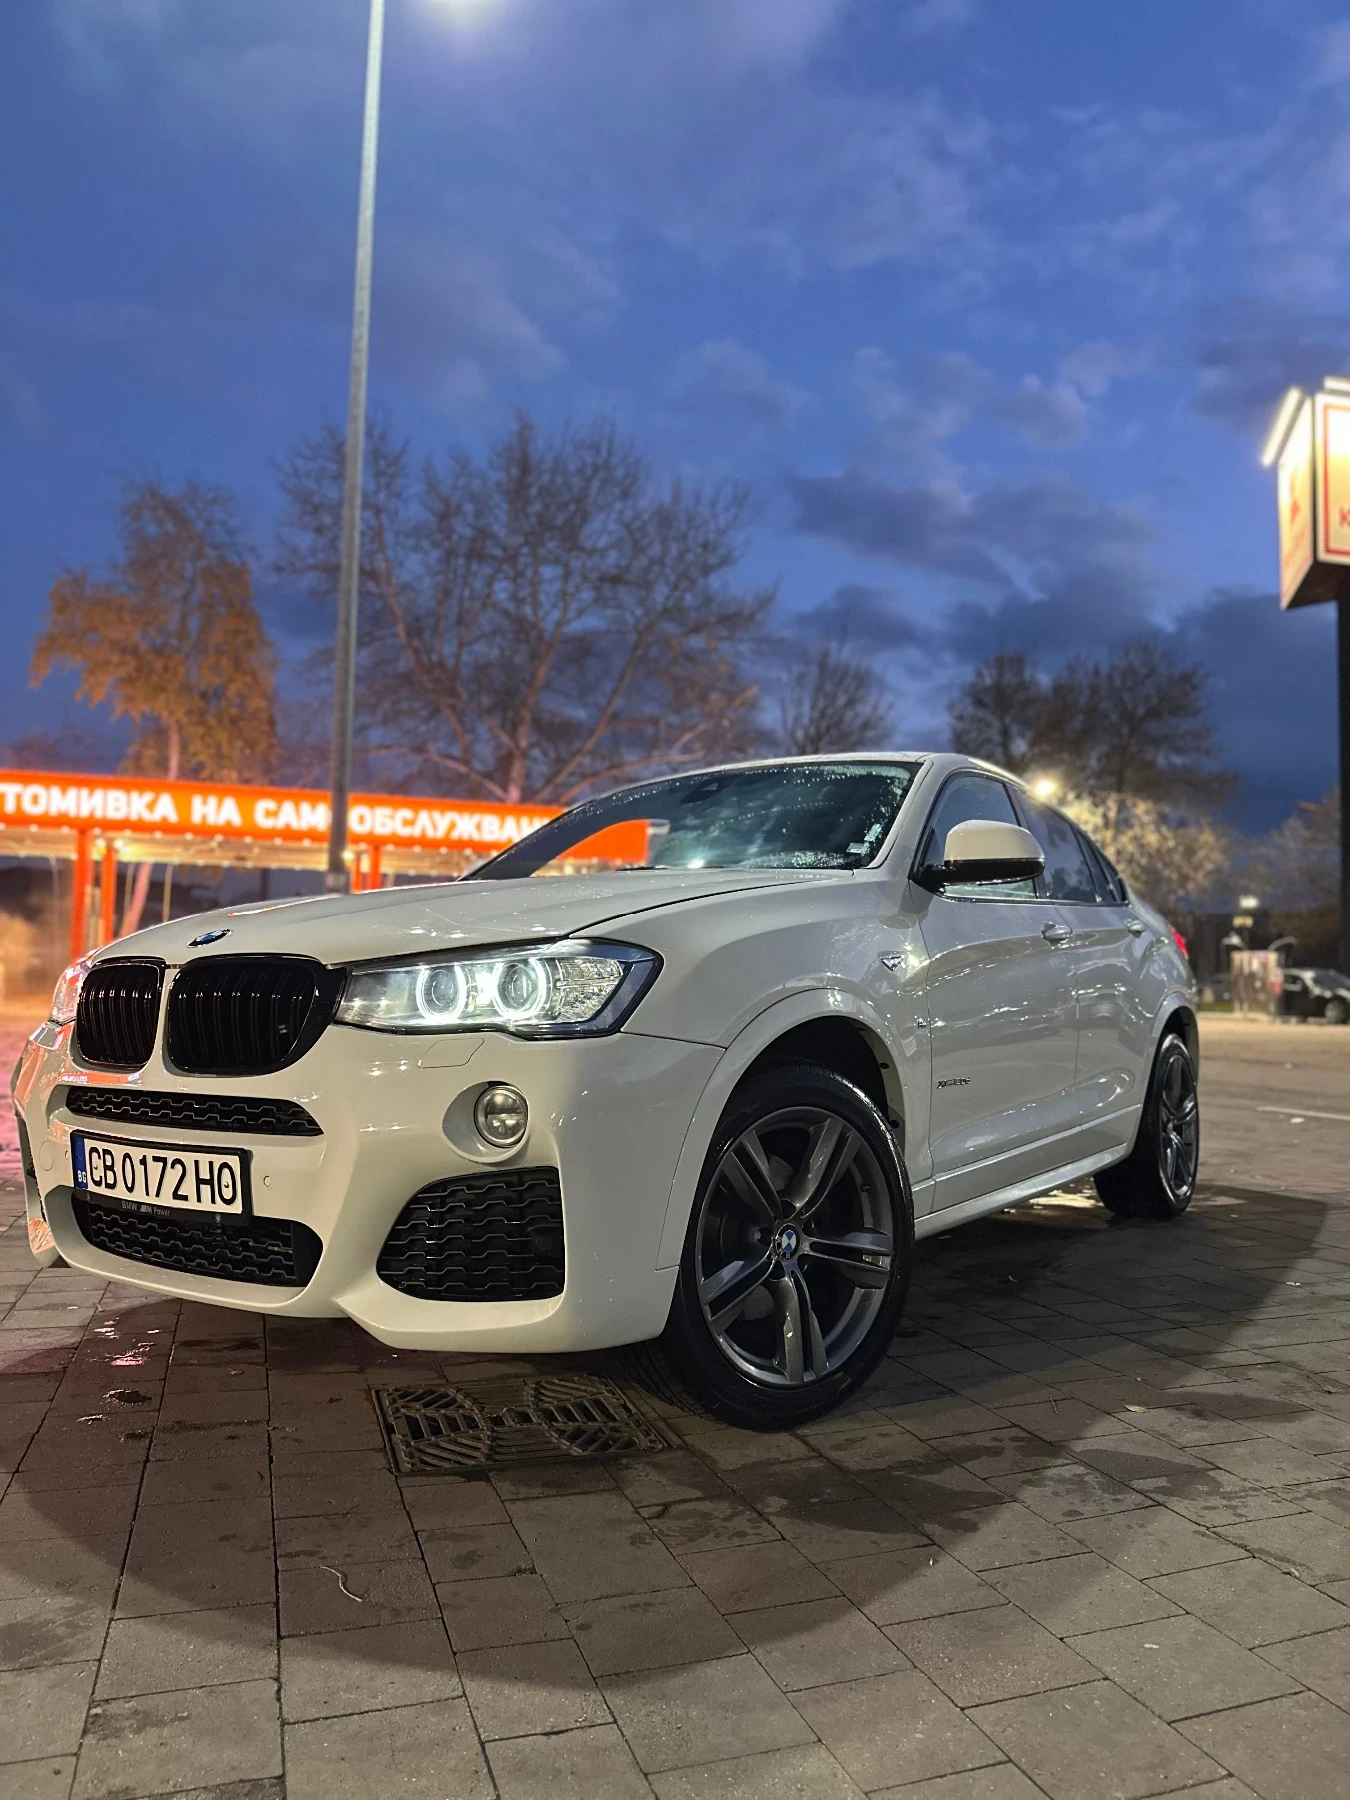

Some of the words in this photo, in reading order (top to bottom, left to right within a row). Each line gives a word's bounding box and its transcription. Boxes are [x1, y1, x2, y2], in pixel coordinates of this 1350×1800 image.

[190, 795, 243, 827] НА
[77, 1170, 87, 1183] BG
[121, 1200, 138, 1211] BMW
